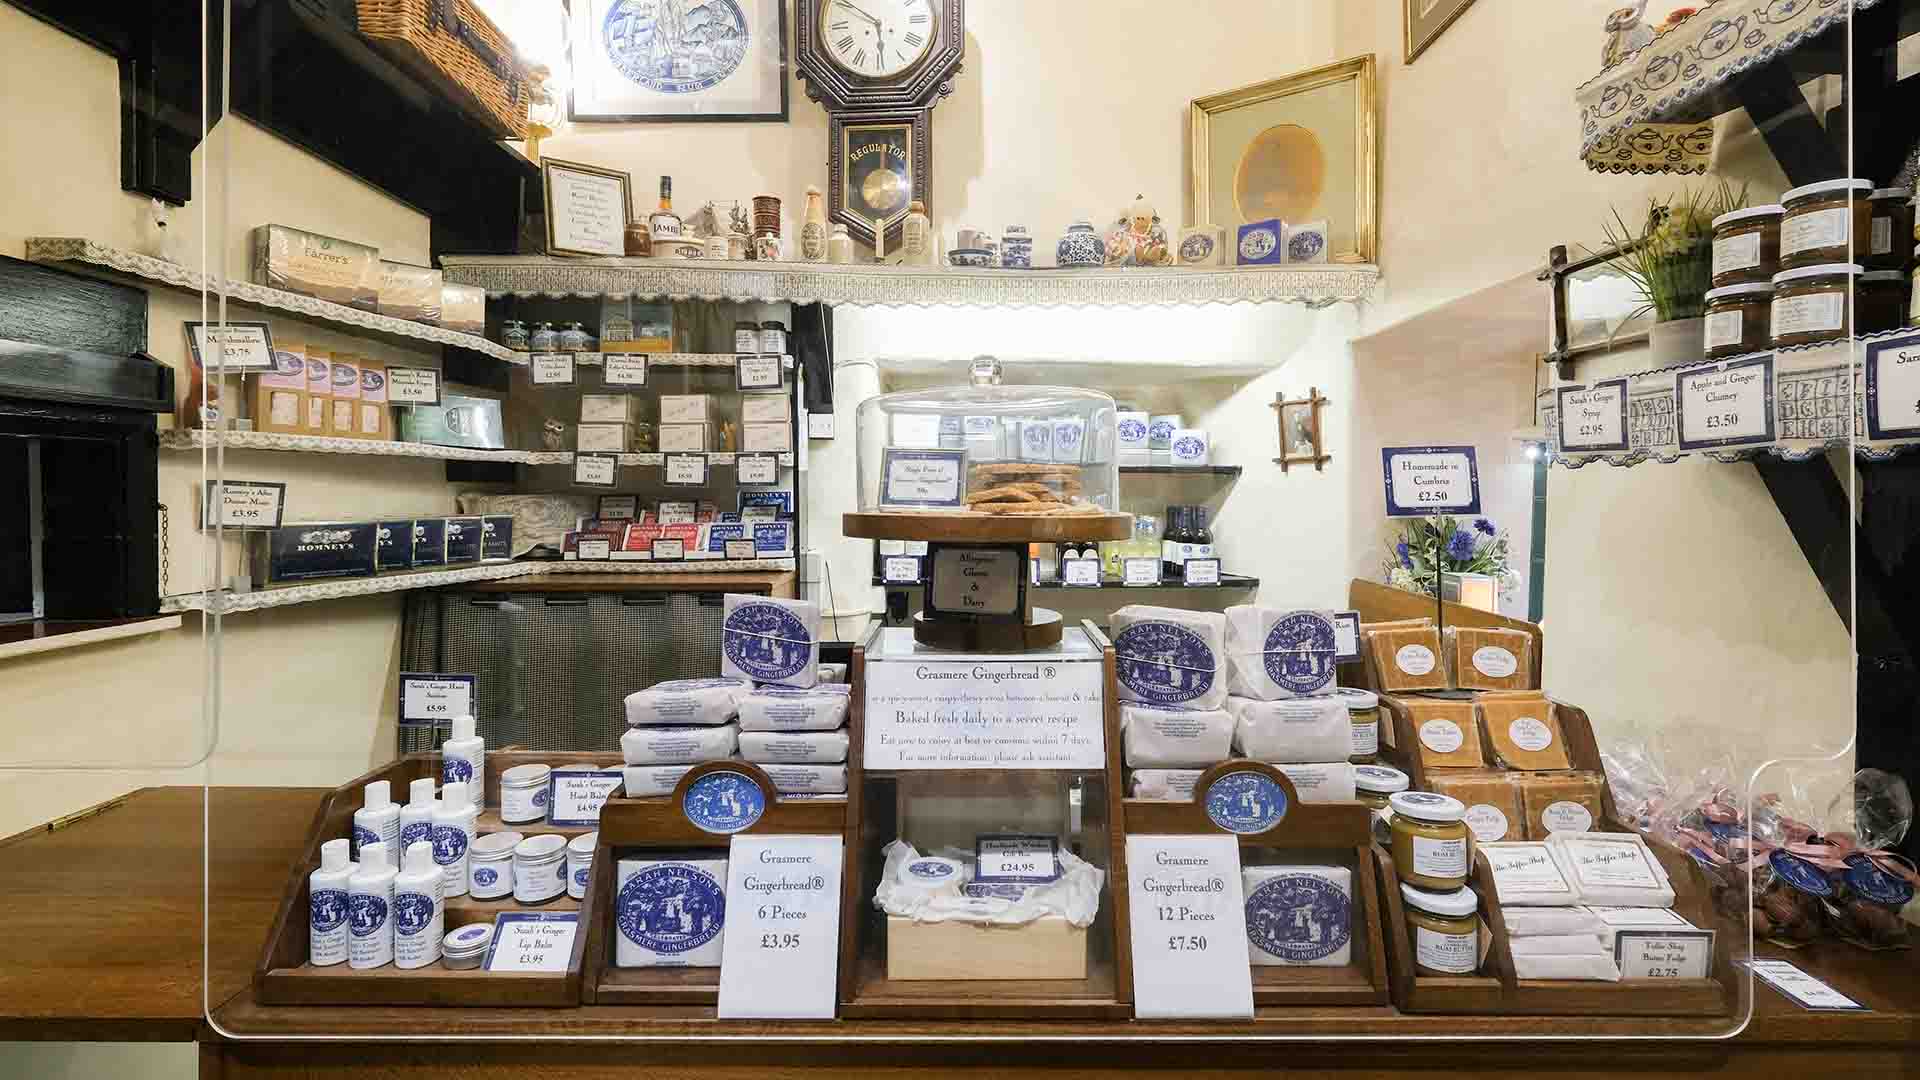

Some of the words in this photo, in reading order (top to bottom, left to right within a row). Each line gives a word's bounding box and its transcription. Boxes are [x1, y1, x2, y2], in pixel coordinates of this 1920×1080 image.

[850, 143, 906, 161] REGULATOR
[1690, 377, 1712, 392] Apple
[1713, 376, 1727, 386] and
[1729, 373, 1755, 385] Ginger
[1569, 394, 1592, 405] Sarah's
[1706, 413, 1738, 428] £3.50
[1580, 424, 1604, 435] £2.95
[1401, 459, 1449, 471] Homemade
[1451, 460, 1458, 470] in
[1413, 475, 1450, 486] Cumbria
[1417, 491, 1448, 502] £2.50
[232, 510, 259, 518] £3.95
[297, 543, 354, 552] ROMNEY'S
[728, 606, 758, 625] SARAH
[757, 658, 806, 679] GINGERBREAD
[915, 666, 969, 681] Grasmere
[971, 666, 1040, 683] Gingerbread
[1043, 666, 1057, 678] ®
[1152, 681, 1209, 701] GINGERBREAD
[426, 704, 447, 712] £5.95
[895, 711, 929, 724] Baked
[933, 711, 959, 724] fresh
[962, 711, 986, 729] daily
[992, 715, 1001, 724] to
[1015, 715, 1044, 724] secret
[1047, 714, 1078, 728] recipe
[880, 734, 896, 745] Eat
[918, 736, 926, 745] to
[928, 735, 951, 748] enjoy
[964, 734, 981, 745] best
[1031, 735, 1059, 745] within
[1061, 734, 1068, 745] 7
[899, 751, 914, 761] For
[993, 751, 1018, 765] please
[1021, 751, 1036, 761] ask
[567, 780, 589, 788] Sarah's
[590, 780, 611, 791] Ginger
[569, 791, 588, 800] Hand
[590, 791, 607, 800] Balm
[576, 804, 598, 812] £4.95
[759, 849, 812, 865] Grasmere
[1155, 850, 1209, 867] Grasmere
[1000, 863, 1035, 872] £24.95
[622, 871, 661, 897] SARAH
[743, 875, 825, 896] Gingerbread®
[1142, 876, 1225, 898] Gingerbread®
[1249, 881, 1289, 906] SARAH
[758, 904, 767, 920] 6
[772, 904, 807, 920] Pieces
[1158, 905, 1175, 922] 12
[1179, 905, 1216, 923] Pieces
[513, 925, 541, 935] Sarah's
[542, 925, 567, 937] Ginger
[618, 915, 657, 949] GRASMERE
[662, 922, 721, 951] GINGERBREAD
[519, 939, 532, 951] Lip
[533, 939, 553, 949] Balm
[761, 934, 801, 949] £3.95
[1168, 935, 1207, 952] £7.50
[1247, 923, 1287, 957] GRASMERE
[1291, 932, 1348, 959] GINGERBREAD
[520, 954, 544, 964] £3.95
[1647, 967, 1678, 977] £2.75
